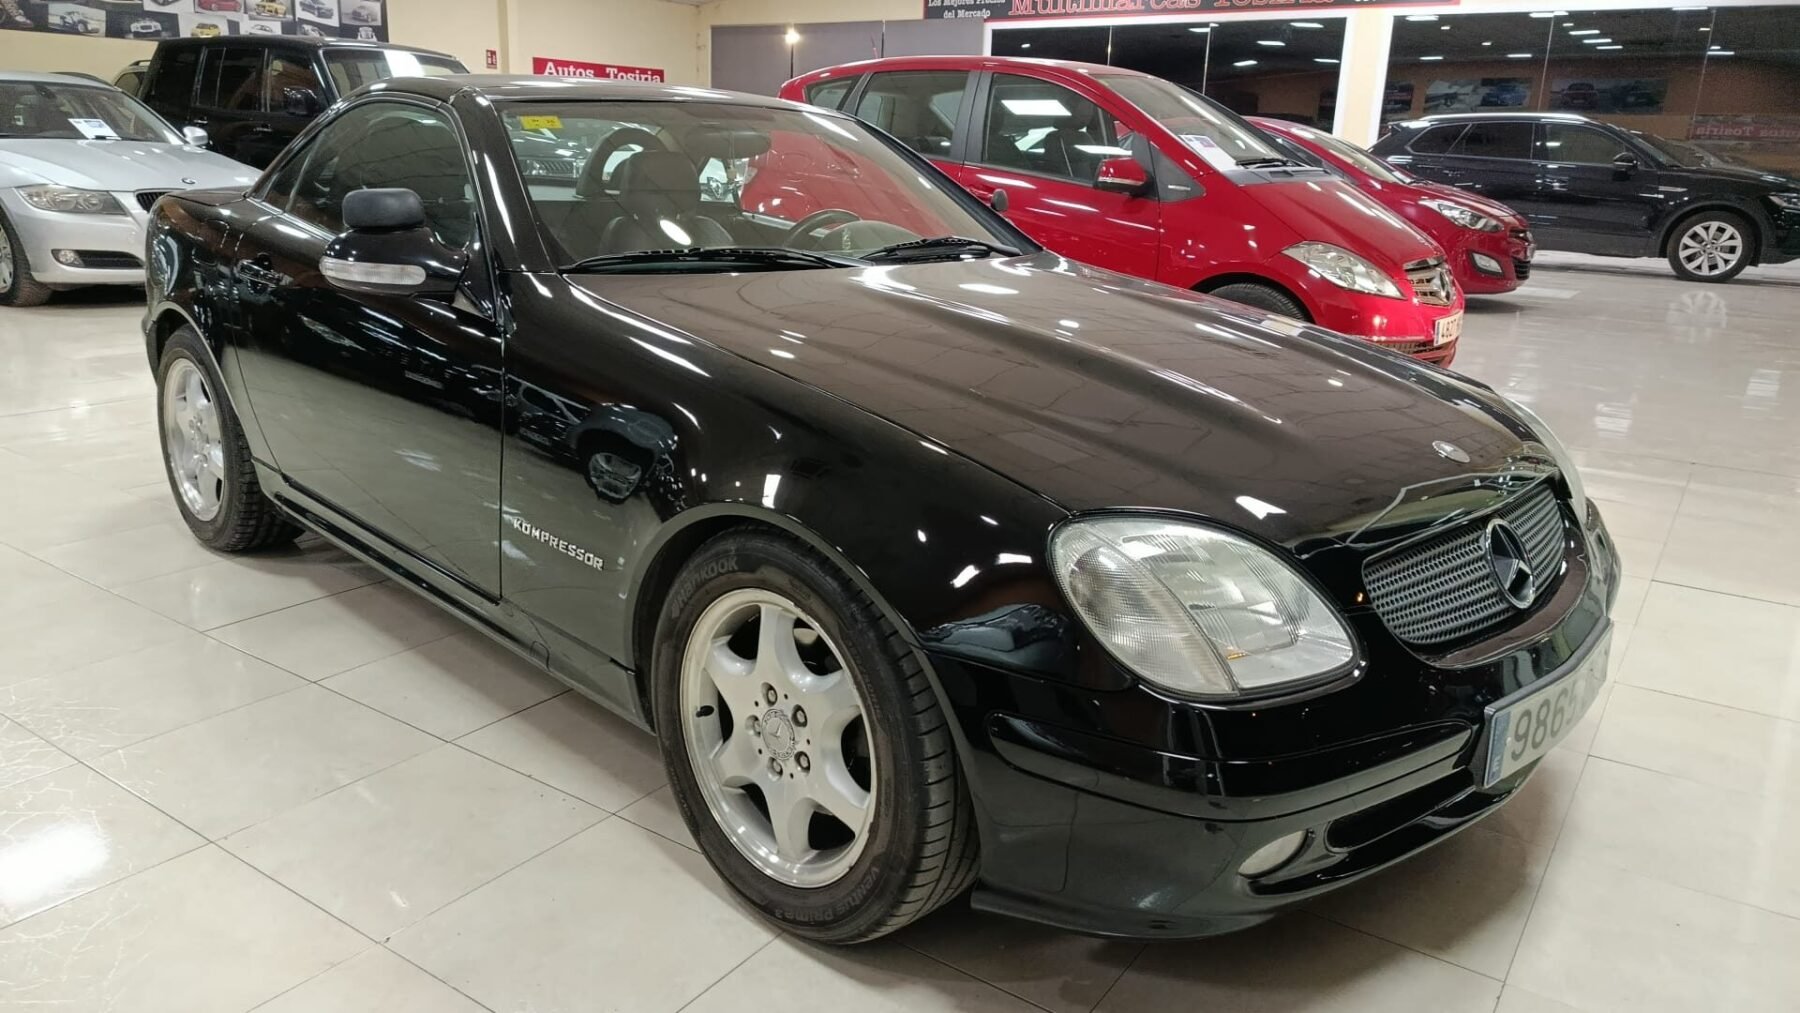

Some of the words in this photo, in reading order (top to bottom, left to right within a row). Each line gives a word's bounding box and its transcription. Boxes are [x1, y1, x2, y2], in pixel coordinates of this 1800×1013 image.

[943, 8, 956, 19] del
[957, 8, 991, 19] Mercado
[543, 61, 595, 79] Autos
[605, 67, 661, 83] Tosiria
[513, 518, 604, 571] KOMPRESSOR
